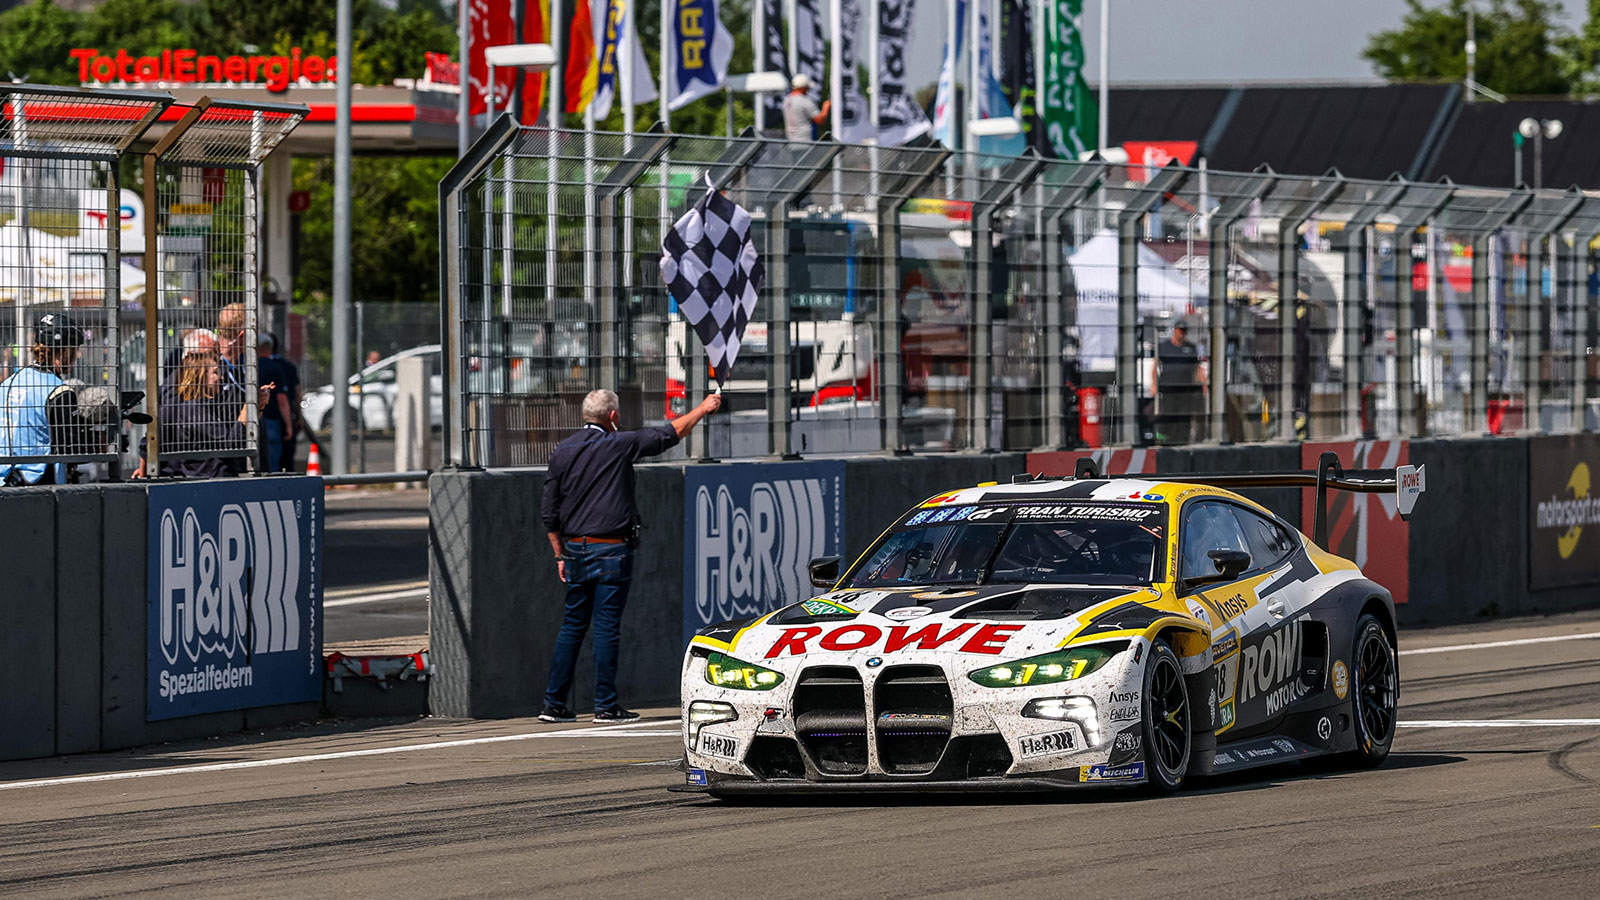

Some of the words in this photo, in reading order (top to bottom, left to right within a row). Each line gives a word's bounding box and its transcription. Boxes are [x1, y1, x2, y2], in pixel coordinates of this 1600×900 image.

[680, 0, 706, 69] RA
[1402, 473, 1420, 488] ROWE
[695, 482, 784, 624] H&R
[160, 504, 254, 665] H&R
[805, 600, 845, 615] DEKR
[1214, 592, 1248, 621] Ansys
[764, 624, 1025, 659] ROWE
[1212, 637, 1236, 657] AVENOL
[159, 663, 253, 702] Spezialfedern
[1109, 691, 1139, 704] Ansys
[1266, 681, 1297, 716] MOTOR
[1110, 706, 1140, 721] ENDLESS
[703, 735, 723, 753] H&R
[1021, 736, 1055, 755] H&R
[1102, 767, 1140, 777] MICHELIN
